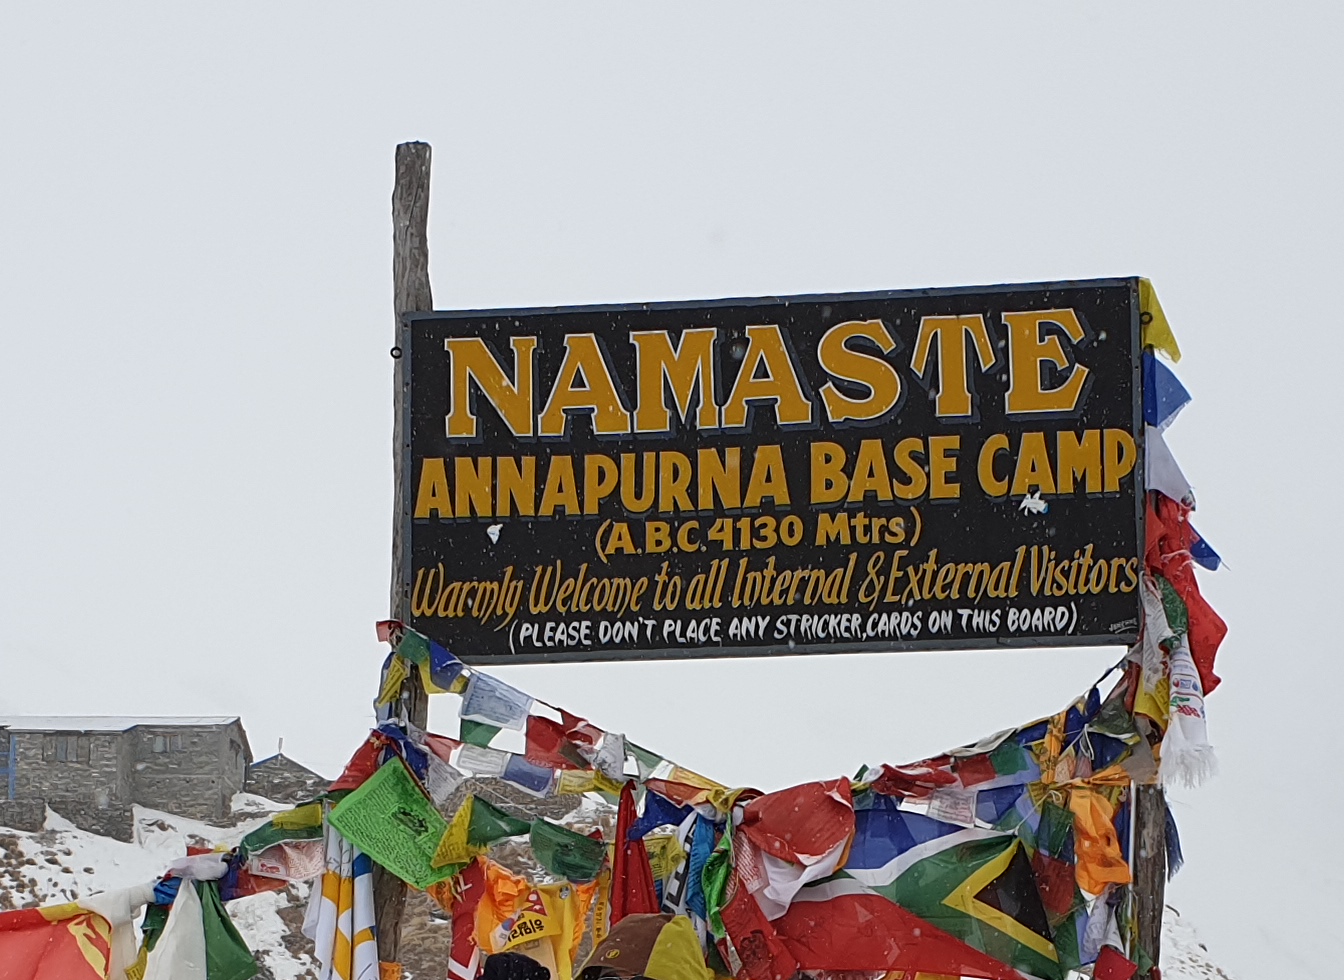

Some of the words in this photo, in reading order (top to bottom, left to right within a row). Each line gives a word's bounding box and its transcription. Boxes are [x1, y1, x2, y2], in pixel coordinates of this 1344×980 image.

[444, 307, 1090, 438] NAMASTE
[413, 444, 791, 520] ANNAPURNA
[809, 436, 960, 505] BASE
[977, 428, 1139, 497] CAMP
[411, 562, 524, 632] Warmly
[528, 559, 649, 618] Welcome
[652, 561, 682, 610] to
[685, 557, 730, 610] all
[731, 551, 858, 609] Internal
[882, 544, 1027, 605] External
[1030, 543, 1139, 597] Visitors
[508, 619, 593, 655] (PLEASE
[598, 617, 657, 645] DON'T
[662, 617, 722, 647] PLACE
[728, 616, 771, 642] ANY
[928, 608, 954, 634] ON
[956, 608, 1002, 634] THIS
[1007, 601, 1078, 635] BOARD)
